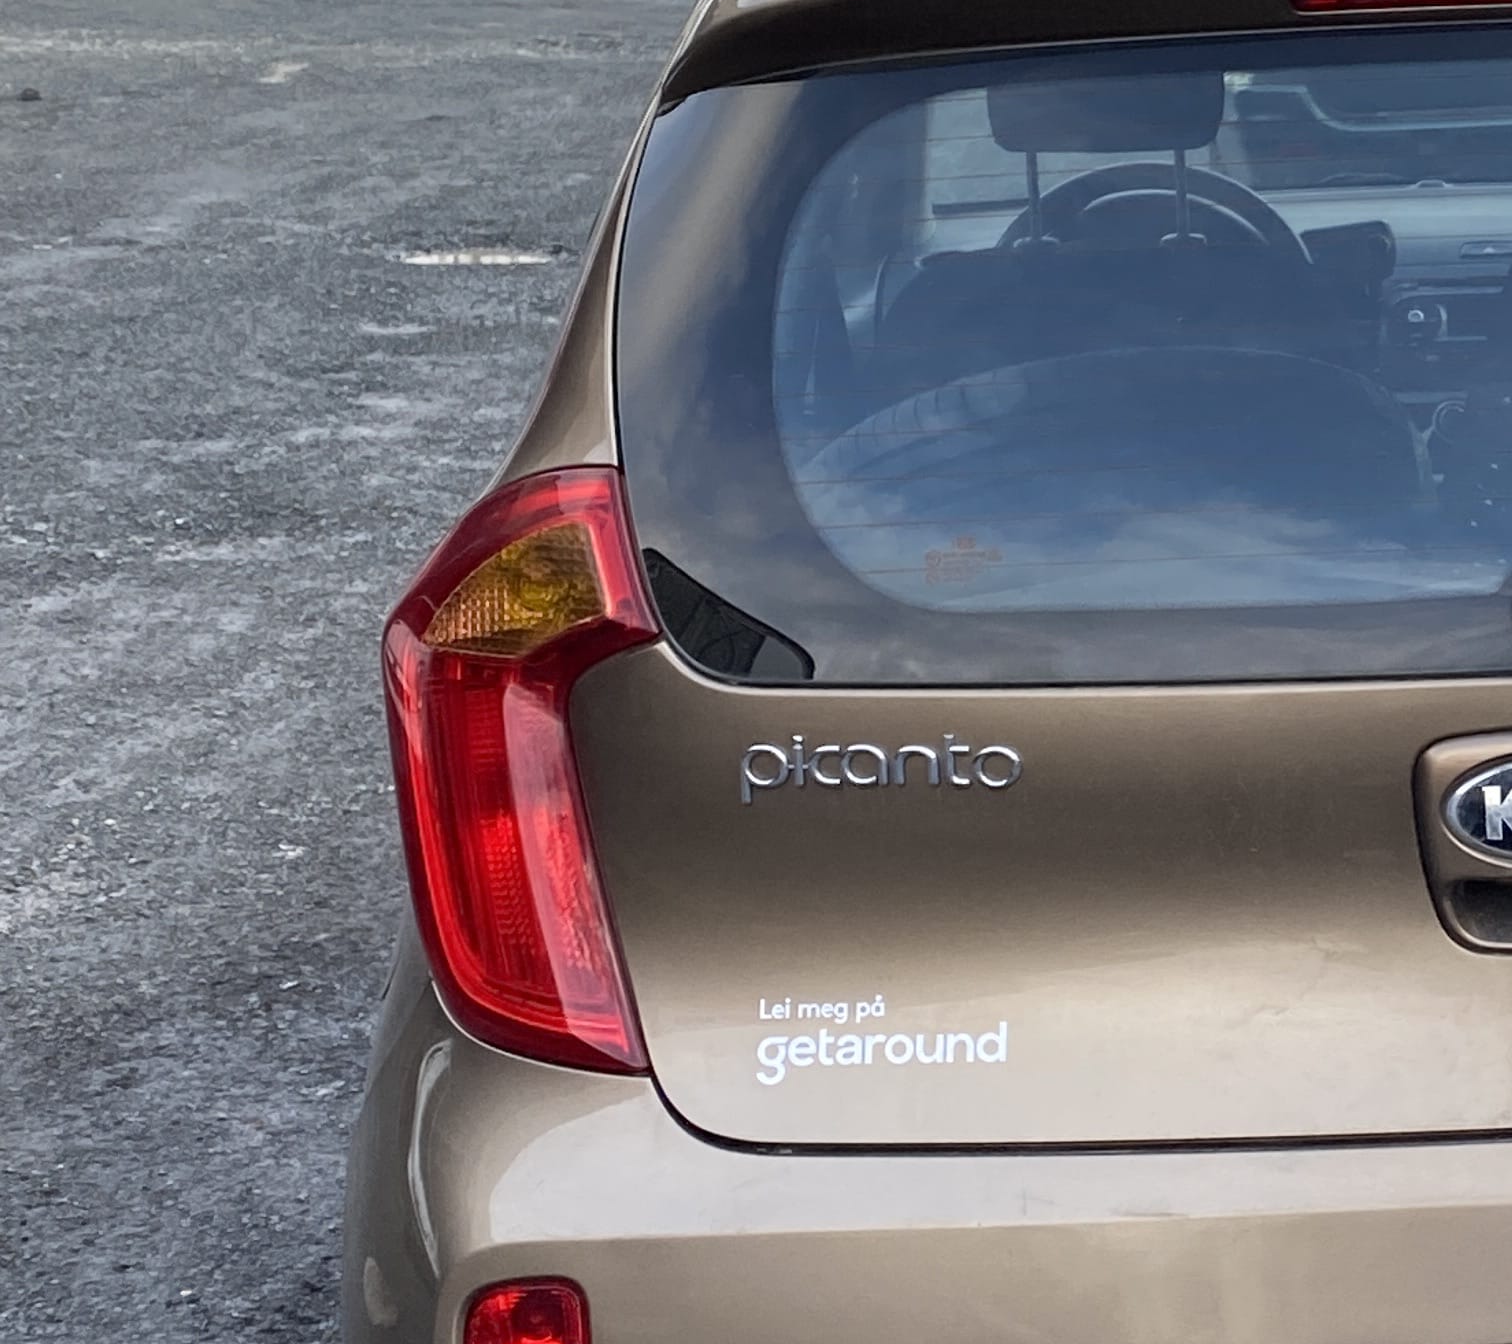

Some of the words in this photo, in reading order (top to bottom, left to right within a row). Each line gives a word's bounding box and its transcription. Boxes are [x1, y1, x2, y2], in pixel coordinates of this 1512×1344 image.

[740, 734, 1023, 805] picanto
[759, 998, 791, 1020] Lei
[797, 1002, 849, 1024] meg
[855, 994, 886, 1023] på
[755, 1020, 1008, 1086] getaround
